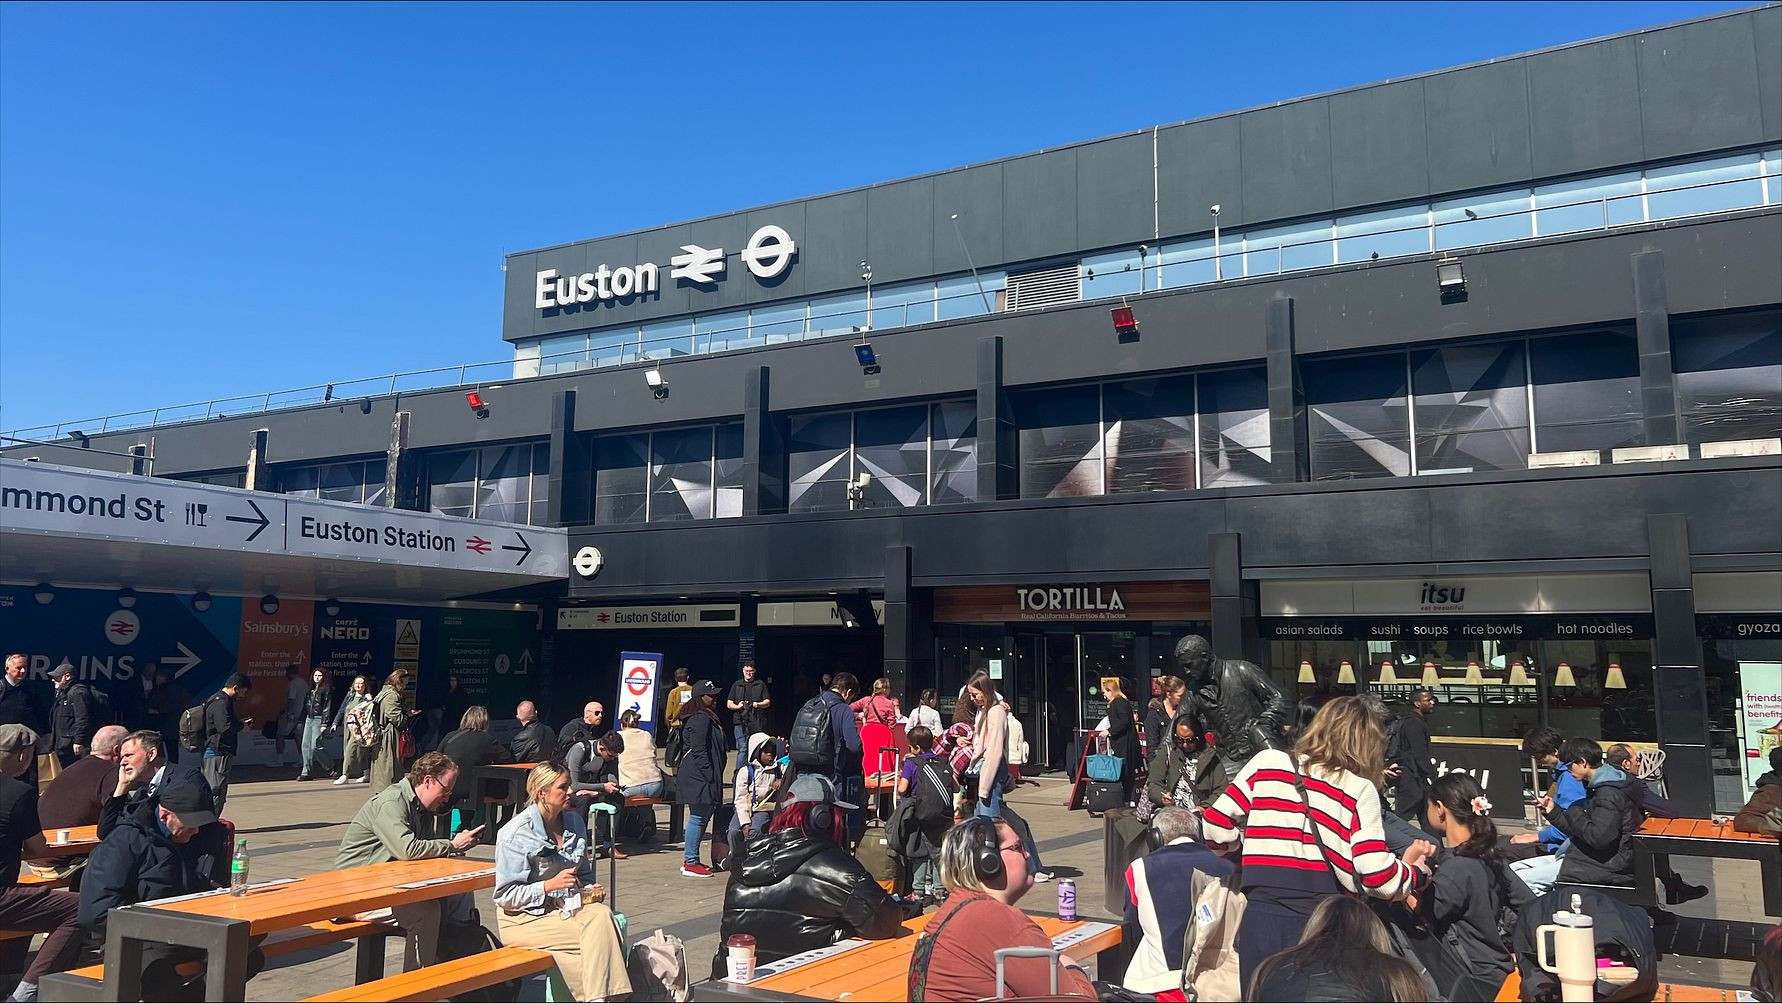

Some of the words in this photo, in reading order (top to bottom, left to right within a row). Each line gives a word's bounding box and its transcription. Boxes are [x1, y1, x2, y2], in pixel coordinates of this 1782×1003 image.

[535, 262, 658, 309] Euston
[134, 498, 165, 523] St
[301, 516, 378, 545] Euston
[383, 526, 455, 552] Station
[1017, 588, 1125, 610] TORTILLA
[1420, 583, 1465, 604] itsu
[614, 612, 650, 624] Euston
[651, 611, 687, 623] Station
[243, 621, 309, 636] Sainsbury's
[320, 627, 370, 640] NERO
[1275, 625, 1304, 635] asian
[1307, 624, 1343, 635] salads
[1371, 625, 1400, 635] sushi
[1413, 625, 1449, 637] soups
[1462, 624, 1485, 635] rice
[1487, 623, 1523, 635] bowls
[1557, 623, 1578, 634] hot
[1581, 622, 1633, 634] noodles
[1737, 623, 1781, 636] gyoza
[27, 654, 136, 681] RINS
[1746, 693, 1782, 702] friends
